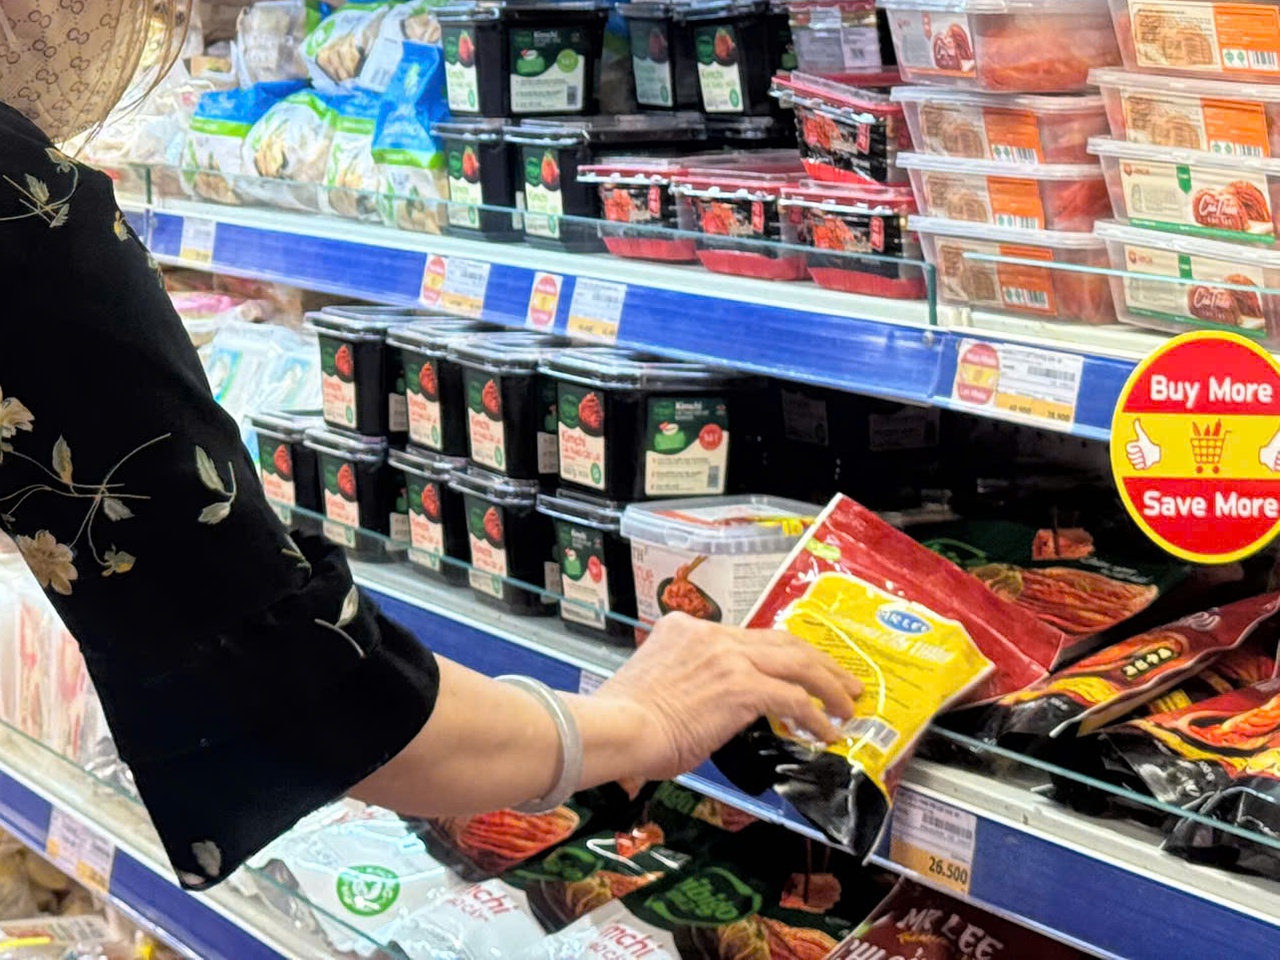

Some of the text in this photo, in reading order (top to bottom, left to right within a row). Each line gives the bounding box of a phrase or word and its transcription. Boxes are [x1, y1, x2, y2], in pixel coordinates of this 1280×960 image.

[1150, 375, 1273, 409] Buy More
[1143, 490, 1279, 519] Save More
[929, 855, 968, 885] 26.500
